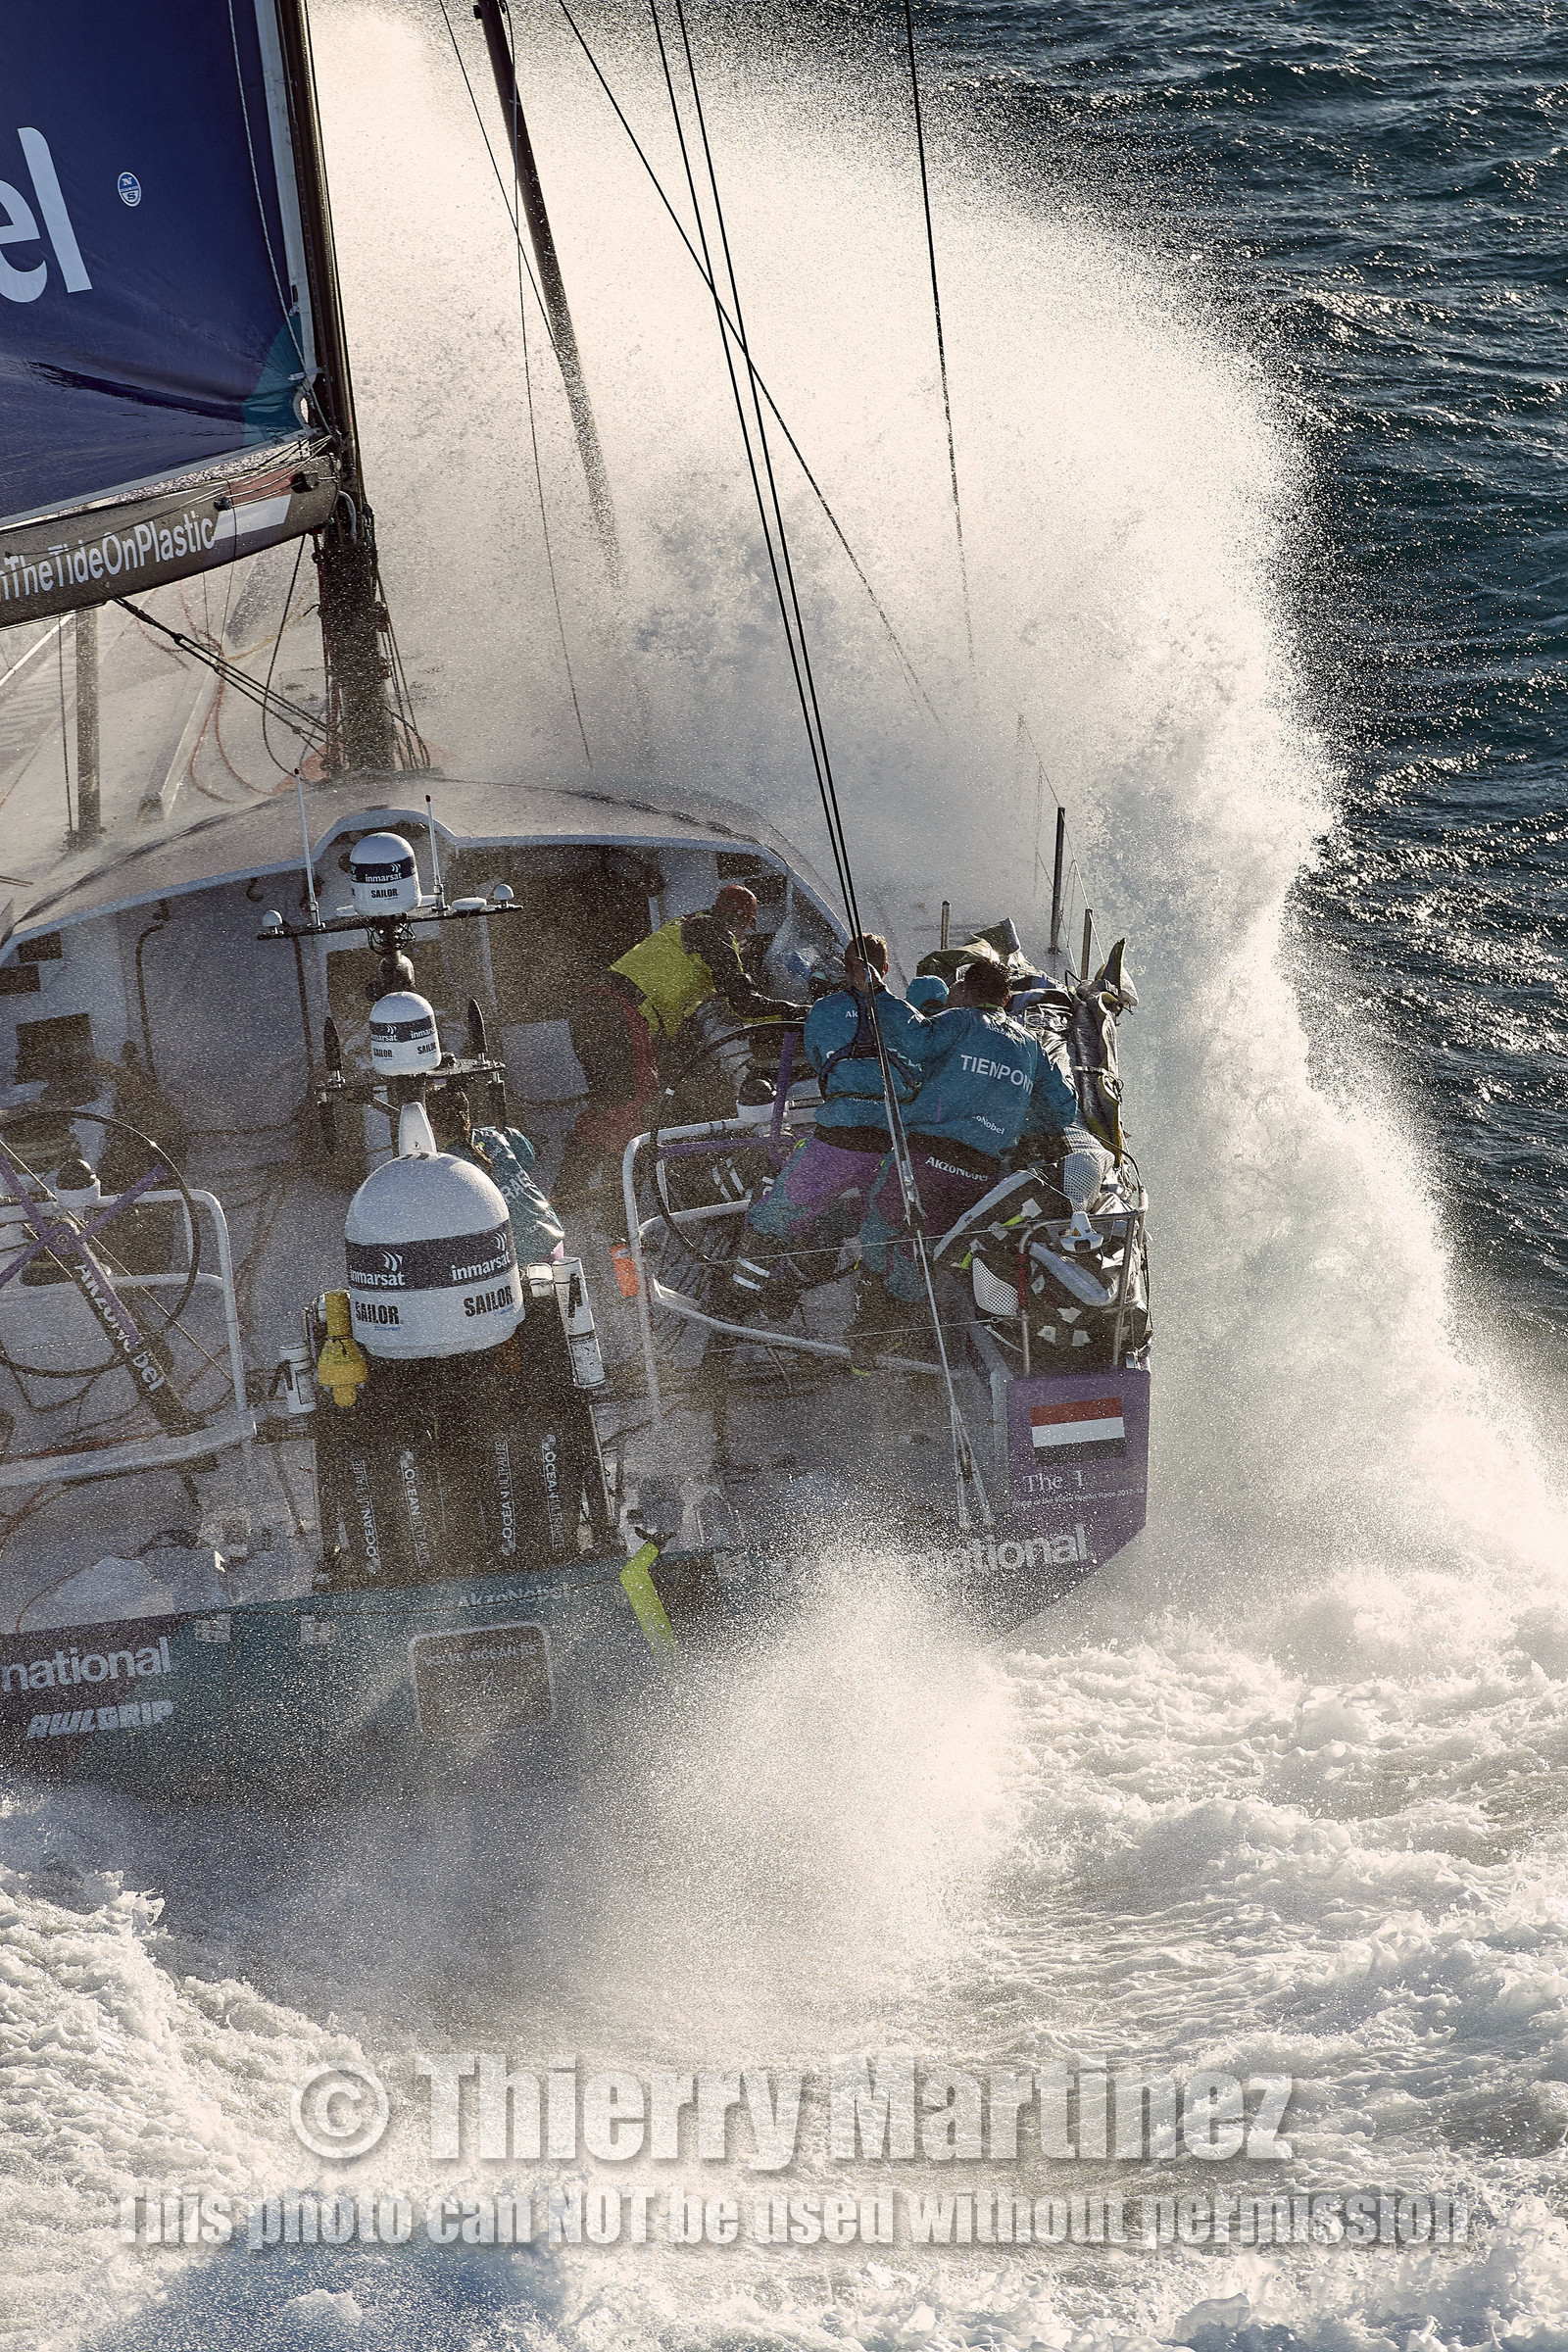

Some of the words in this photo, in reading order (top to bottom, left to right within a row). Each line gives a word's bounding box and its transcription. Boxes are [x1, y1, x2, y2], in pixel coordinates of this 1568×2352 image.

[365, 871, 403, 883] inmarsat
[370, 888, 398, 899] SAILOR
[451, 1250, 512, 1282] inmarsat
[354, 1300, 400, 1325] SAILOR
[463, 1285, 514, 1318] SAILOR
